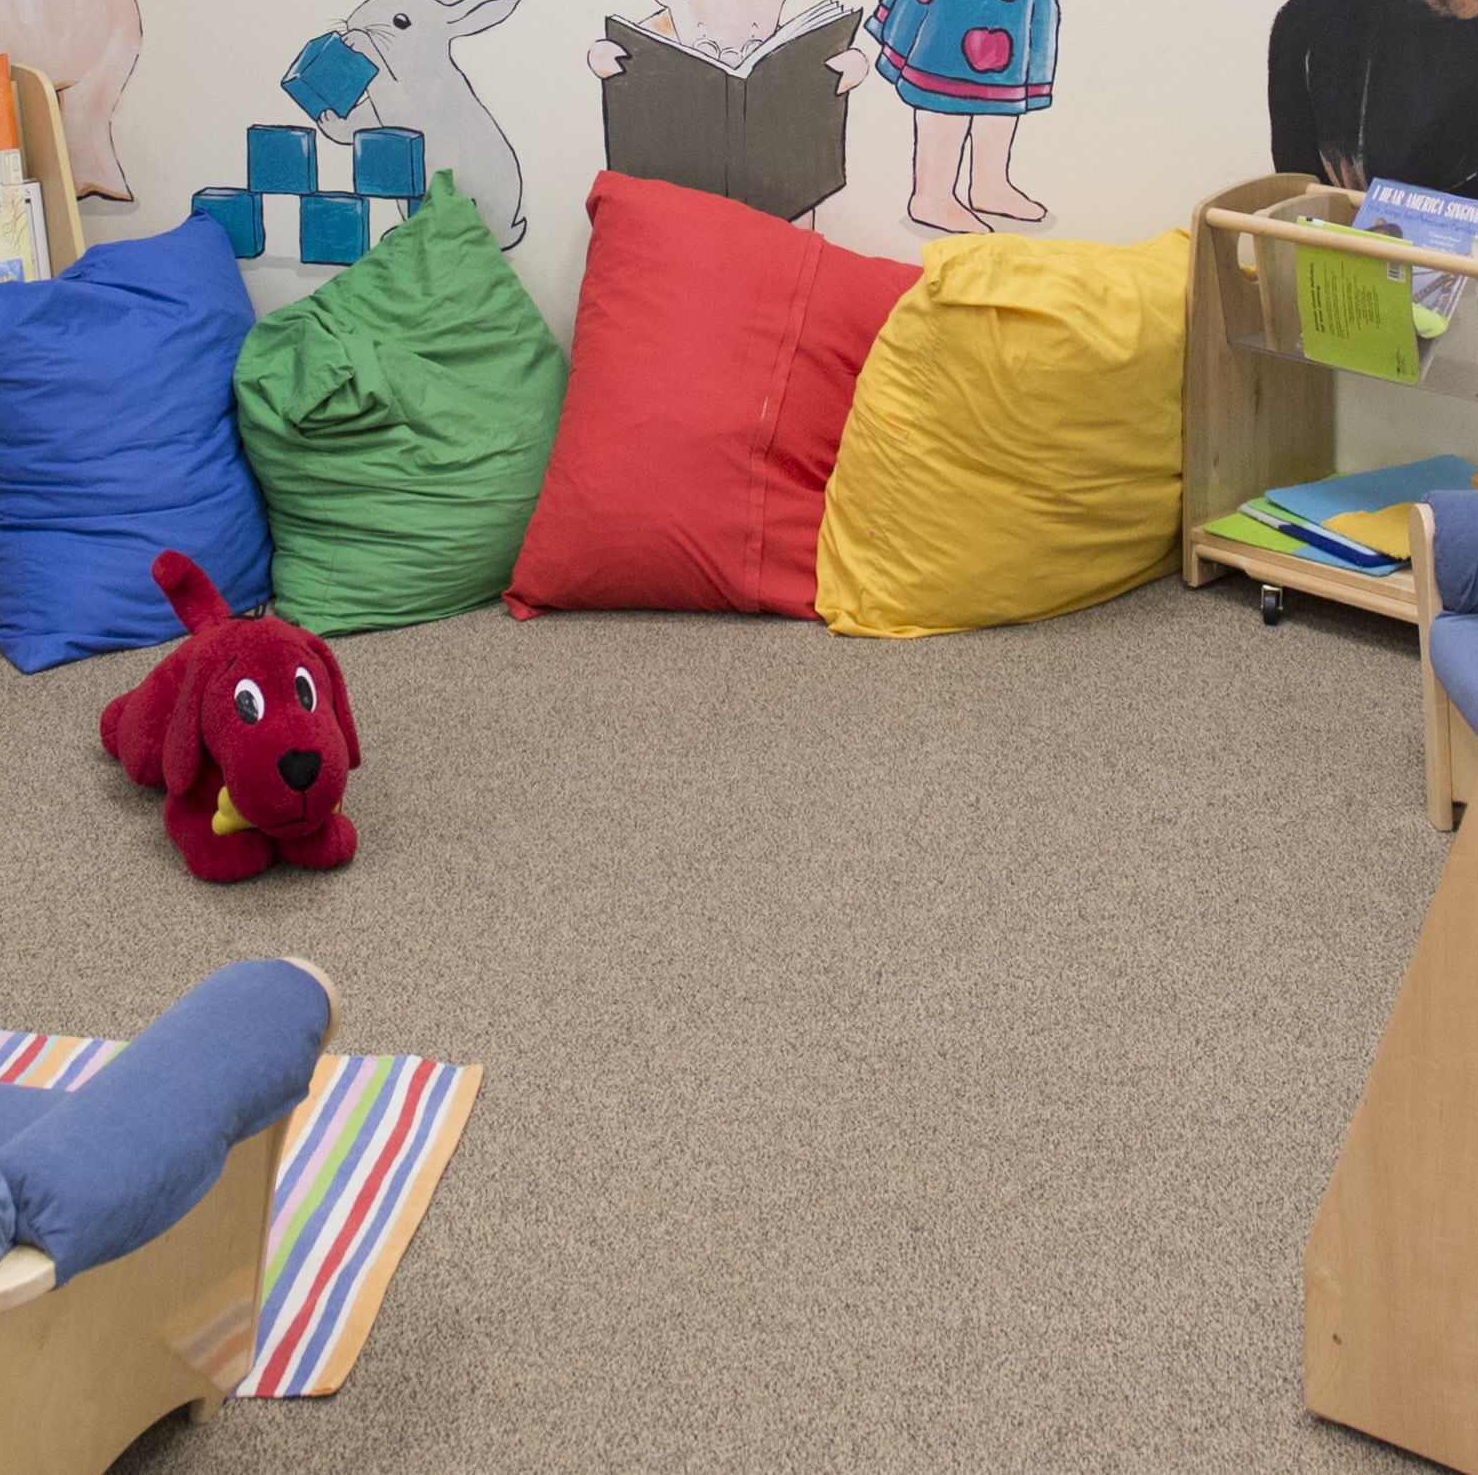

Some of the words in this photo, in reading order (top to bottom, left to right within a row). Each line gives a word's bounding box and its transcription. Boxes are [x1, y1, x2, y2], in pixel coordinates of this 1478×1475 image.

[1372, 184, 1381, 201] I
[1379, 186, 1405, 207] HEAR
[1403, 193, 1445, 216] AMERICA
